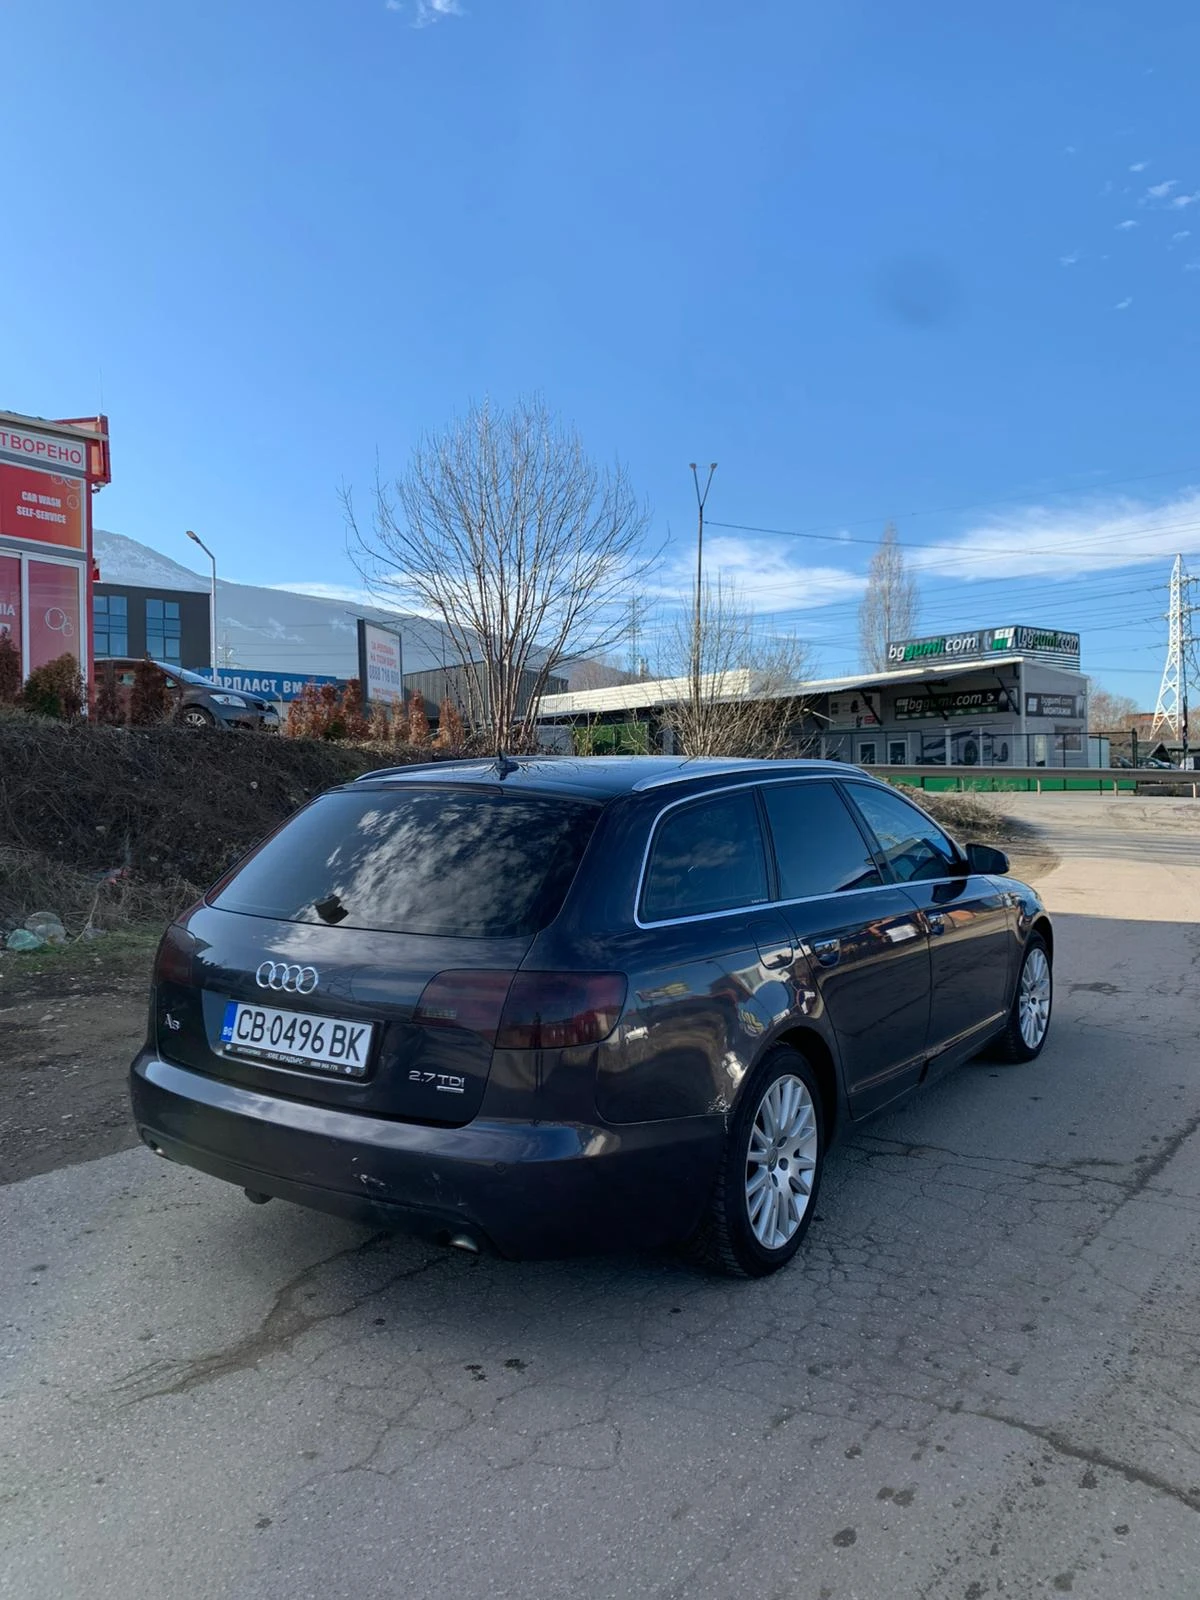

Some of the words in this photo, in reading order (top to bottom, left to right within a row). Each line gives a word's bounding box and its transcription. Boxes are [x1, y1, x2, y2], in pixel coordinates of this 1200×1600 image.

[21, 491, 38, 505] CAR
[38, 494, 61, 508] WASH
[16, 506, 66, 524] SELF-SERVICE
[222, 1025, 233, 1037] BG
[269, 1014, 325, 1054] 0496
